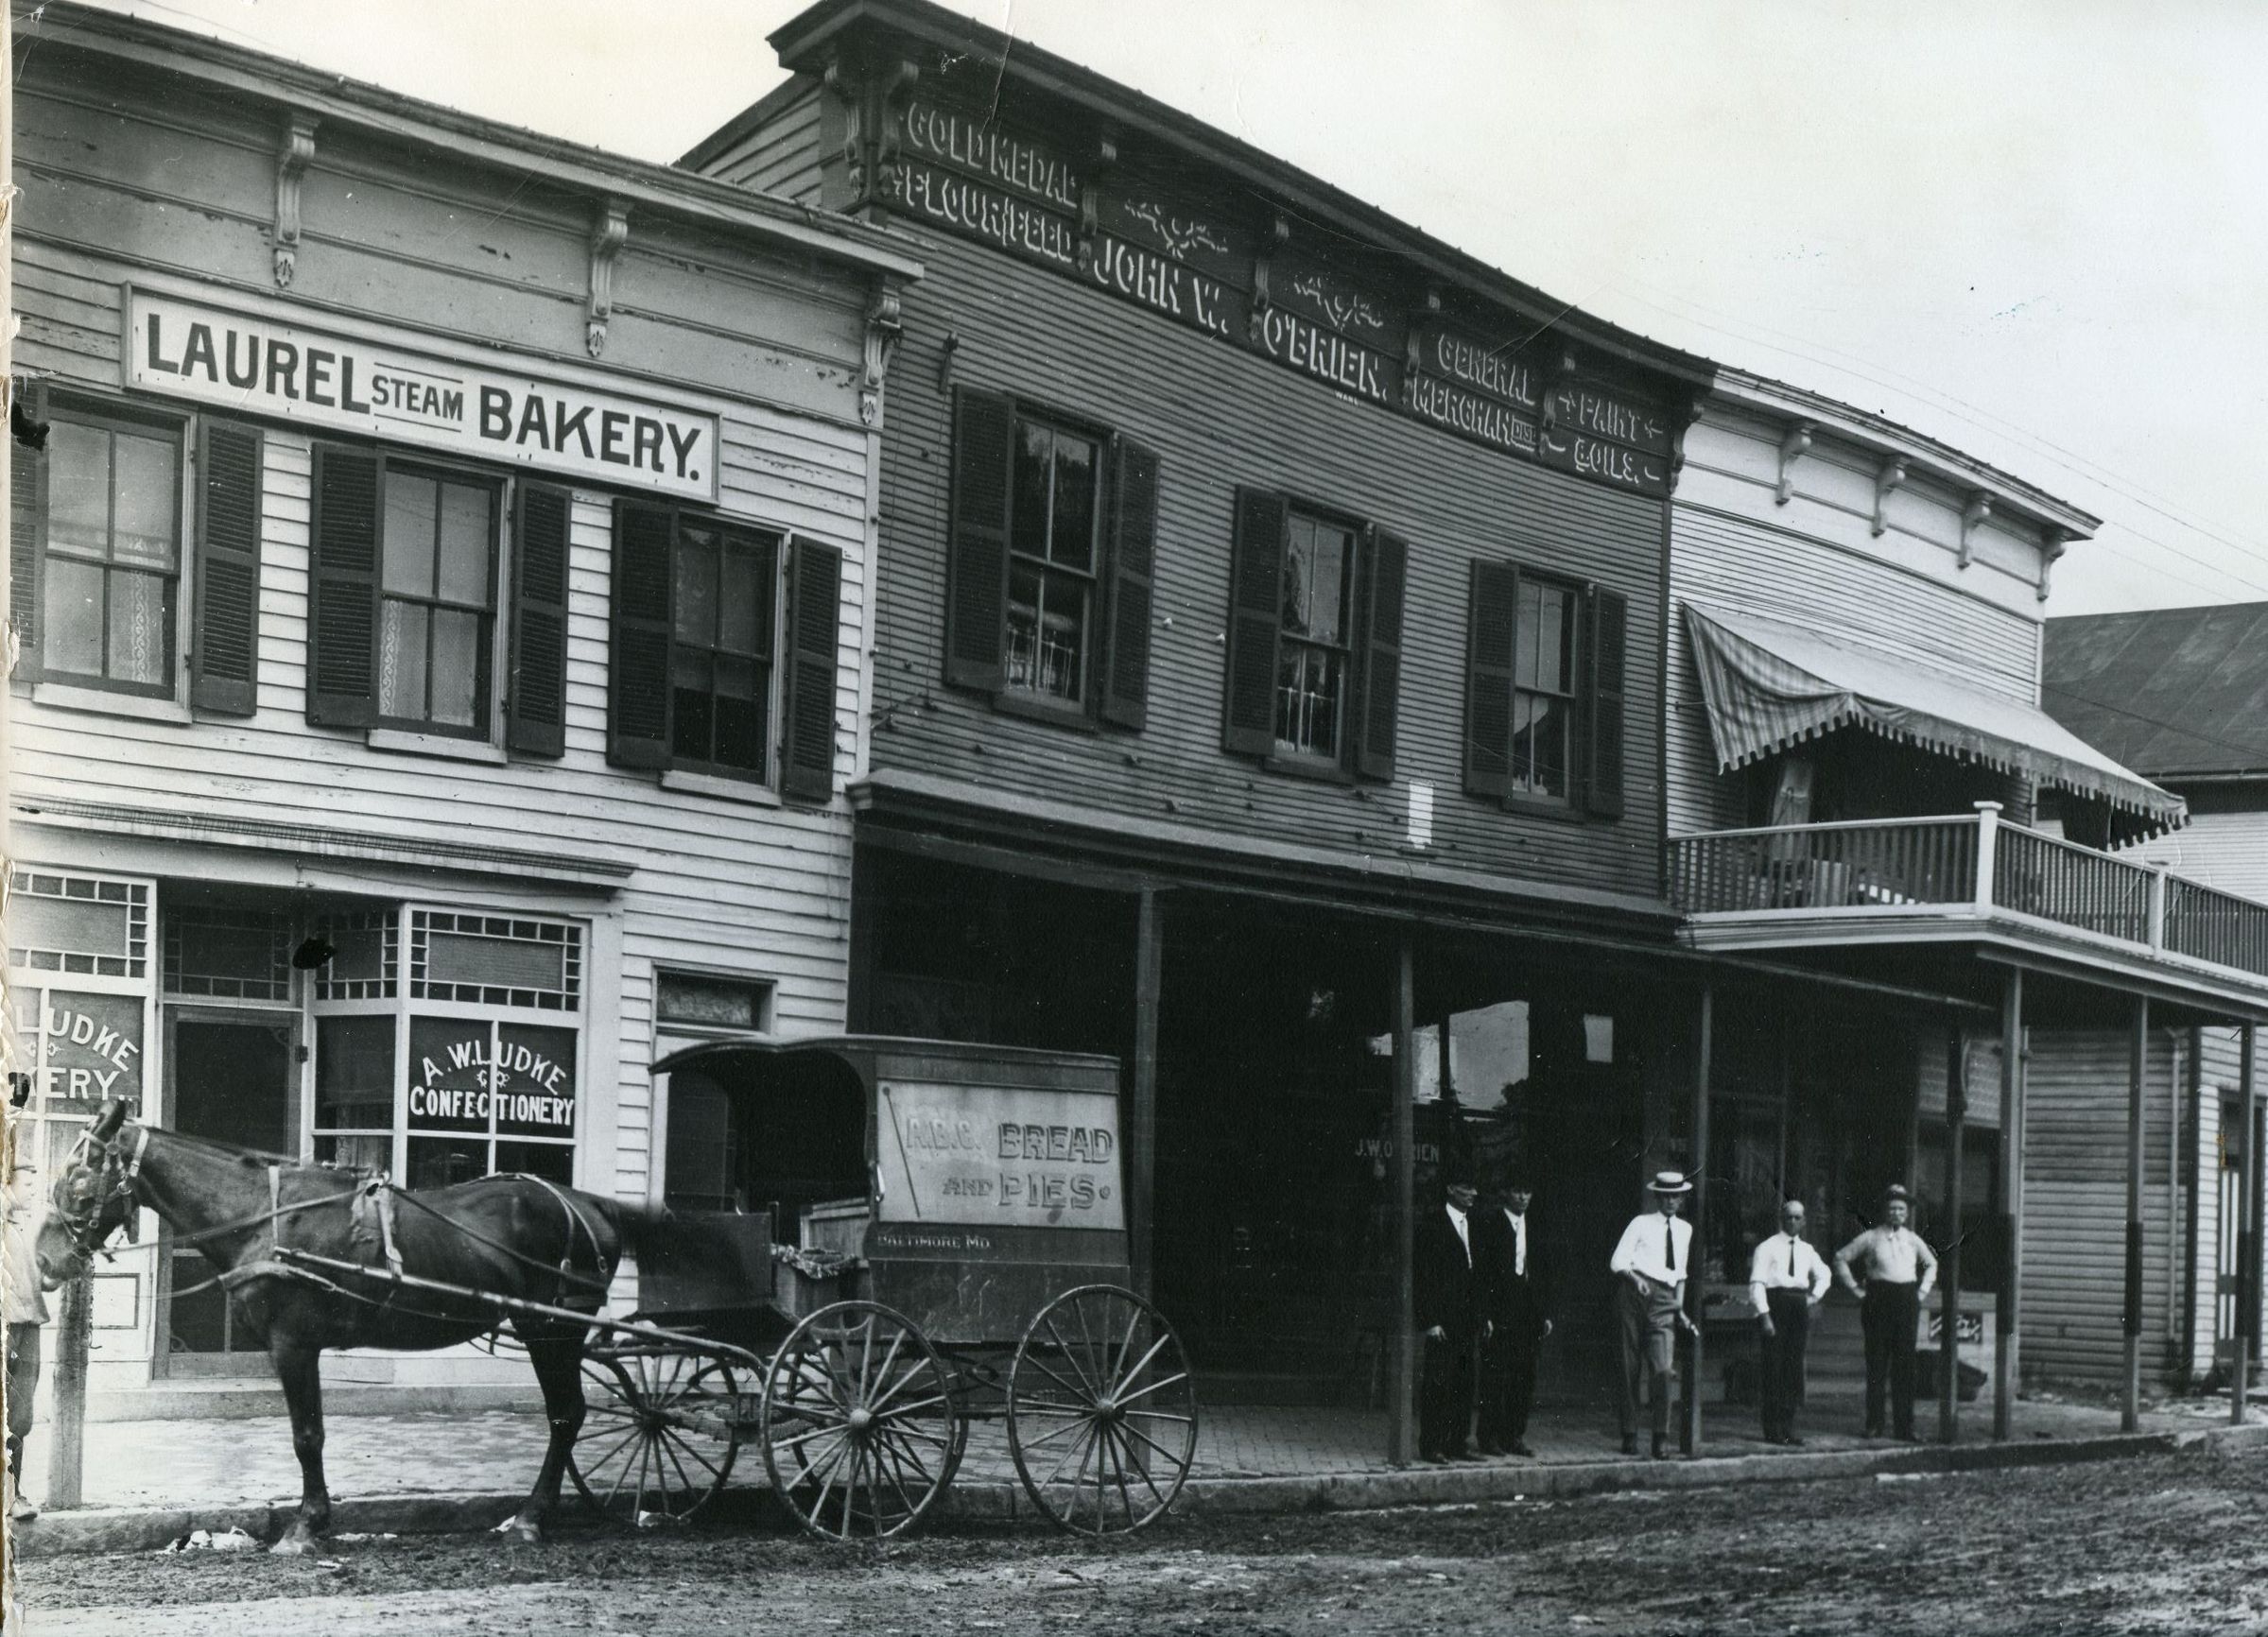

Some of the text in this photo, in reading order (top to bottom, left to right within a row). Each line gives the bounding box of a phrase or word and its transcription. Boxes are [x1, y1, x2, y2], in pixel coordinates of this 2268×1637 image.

[1093, 238, 1182, 315] JOHN
[1437, 333, 1536, 406] GENERAL
[147, 313, 701, 481] LAUREL STEAM BAKERY.
[1579, 392, 1641, 442] PAINT
[16, 1005, 140, 1073] LUDKE
[409, 1086, 575, 1126] CONFECTIONERY
[997, 1122, 1114, 1164] BREAD
[942, 1178, 993, 1197] AND
[877, 1234, 961, 1249] BALTIMORE
